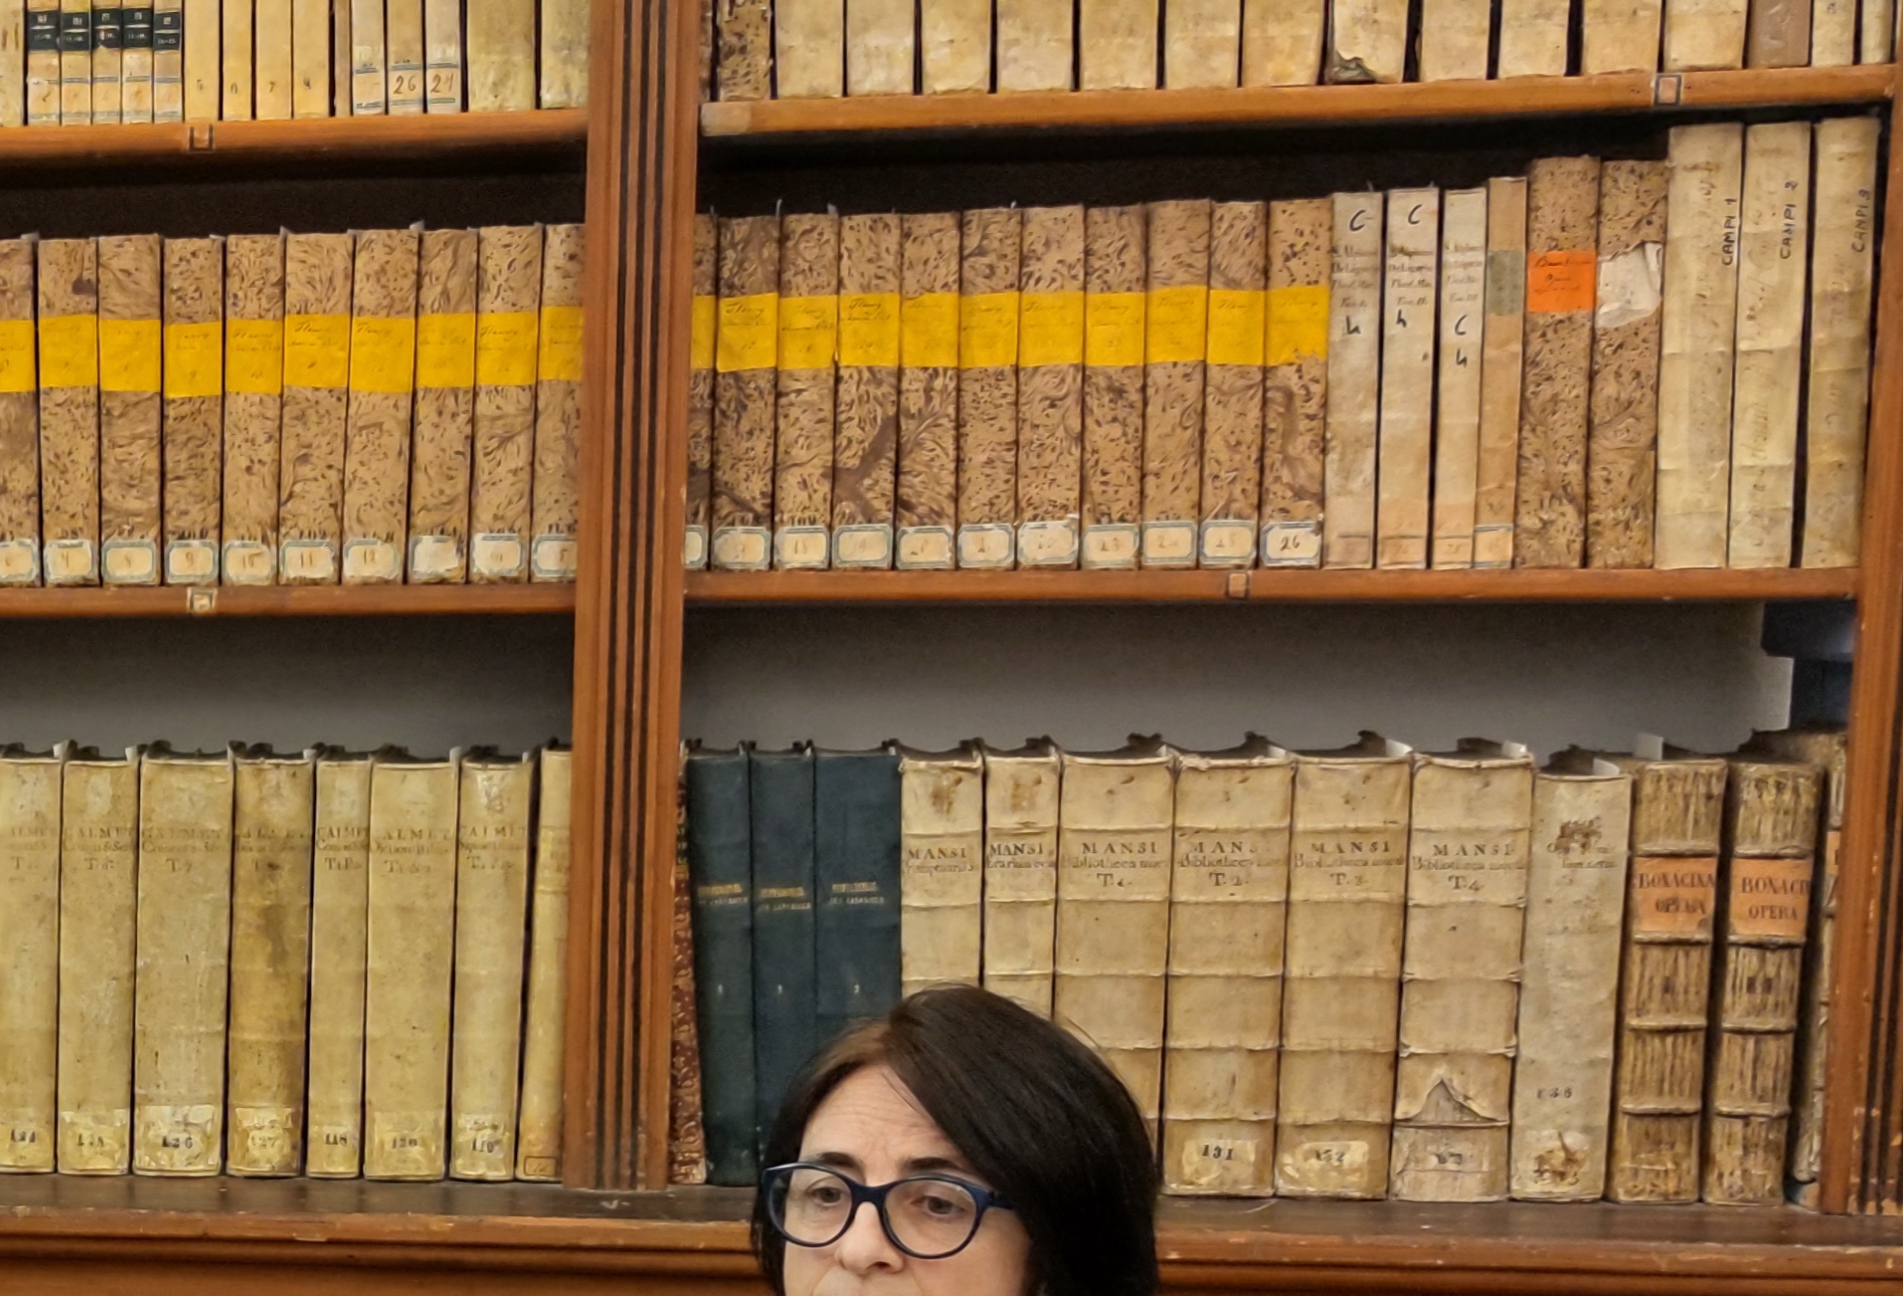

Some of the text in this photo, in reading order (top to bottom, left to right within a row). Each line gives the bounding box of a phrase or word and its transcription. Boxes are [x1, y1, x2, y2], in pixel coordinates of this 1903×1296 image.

[393, 74, 417, 95] 26
[1780, 203, 1797, 260] CAMPI
[1721, 213, 1736, 267] CAMPI
[1279, 536, 1301, 552] 26
[907, 847, 968, 860] MANSI
[989, 842, 1044, 857] MANSI
[1081, 841, 1157, 855] MANSI
[1311, 841, 1390, 854] MANSI
[1433, 843, 1515, 857] MANSI
[1748, 904, 1798, 921] OPERA
